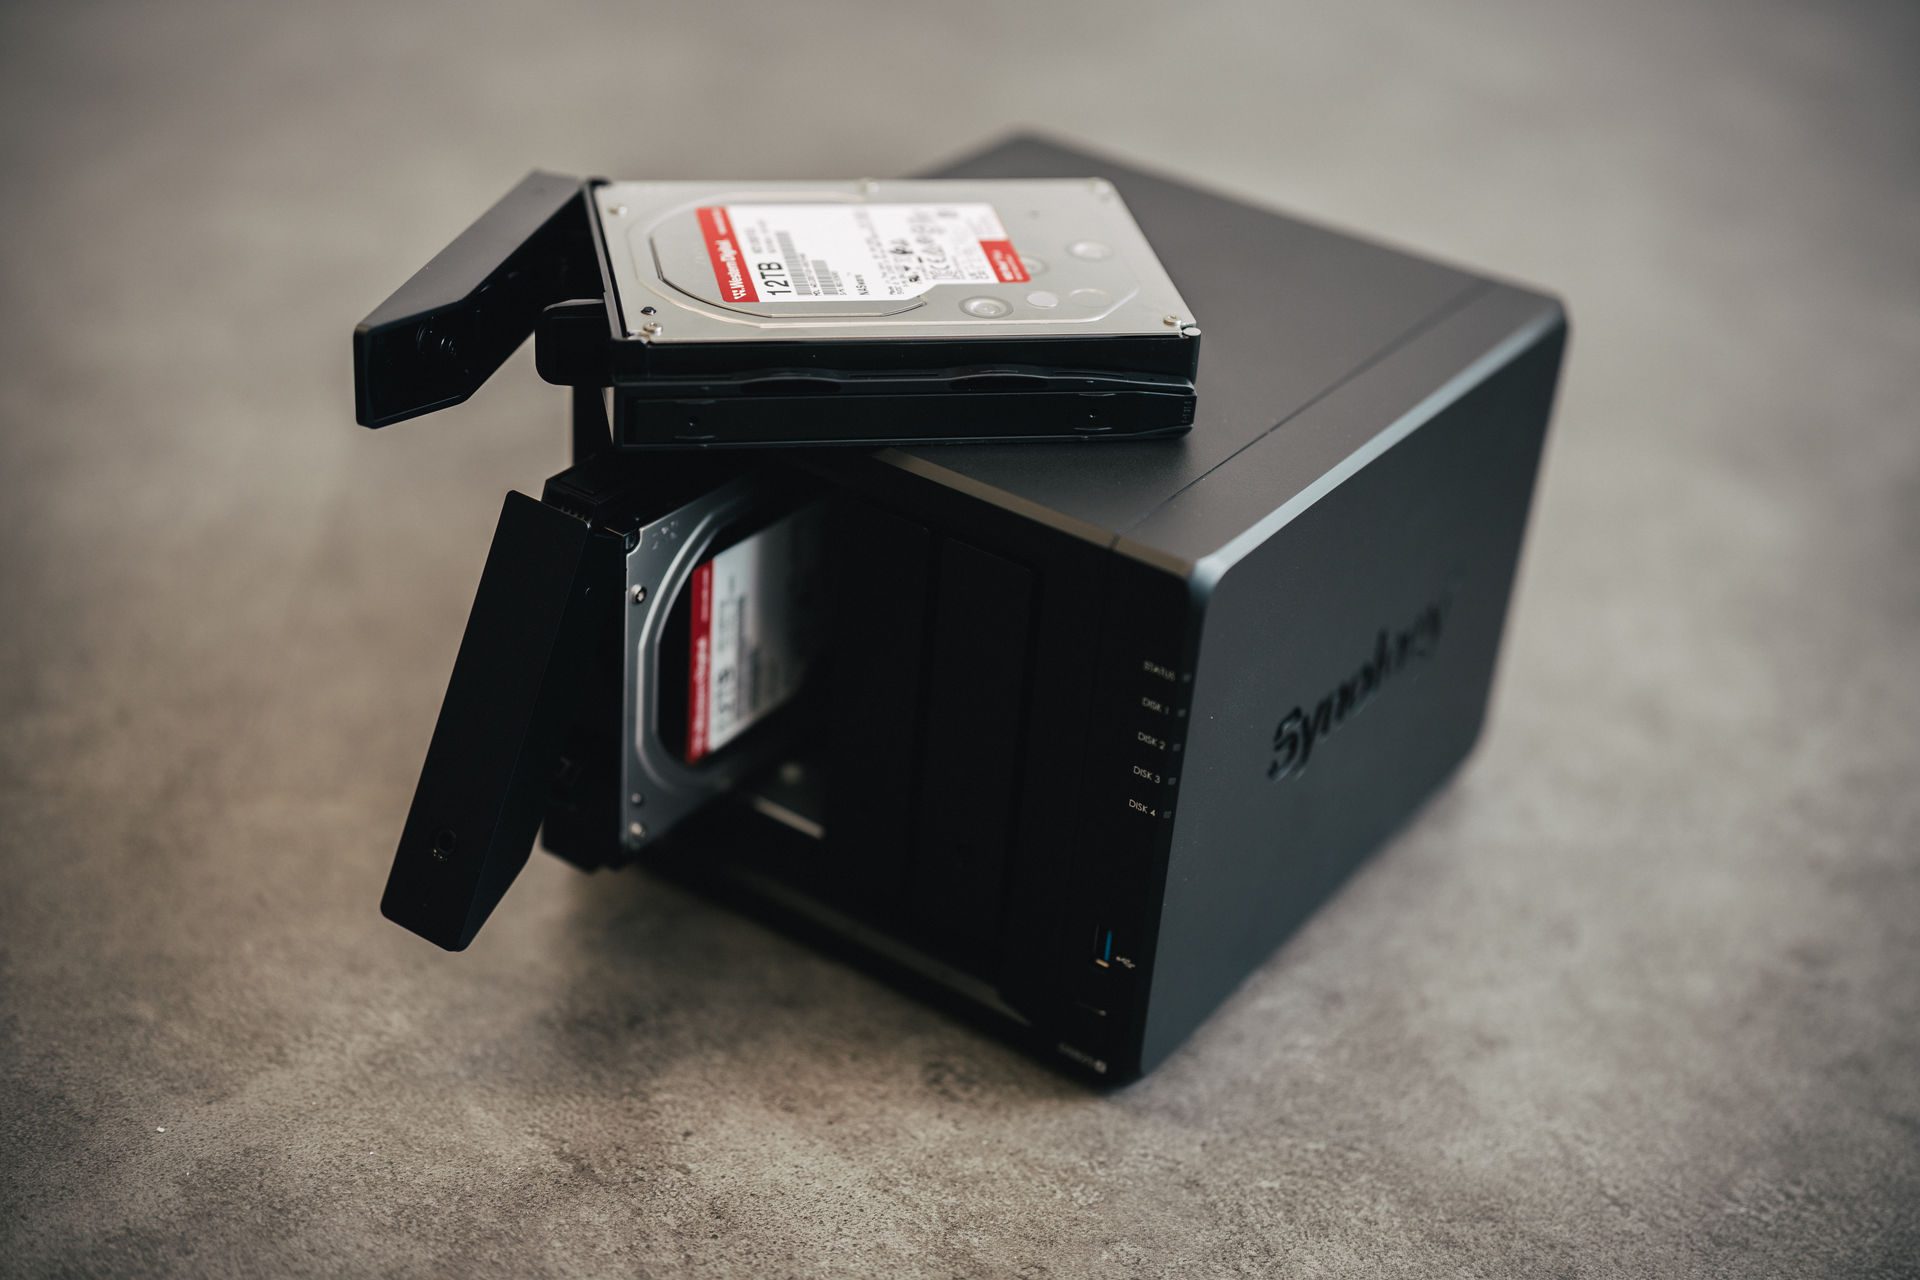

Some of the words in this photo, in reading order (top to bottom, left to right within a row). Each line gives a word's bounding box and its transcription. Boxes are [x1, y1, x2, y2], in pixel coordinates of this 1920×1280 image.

[715, 239, 738, 263] Digital
[725, 260, 745, 290] Western
[757, 261, 792, 297] 12TB
[1142, 697, 1161, 713] DISK
[1137, 731, 1157, 746] DISK
[1159, 740, 1167, 751] 2
[1133, 765, 1153, 781] DISK
[1154, 775, 1161, 784] 3
[1128, 798, 1148, 815] DISK
[1150, 809, 1157, 817] 4
